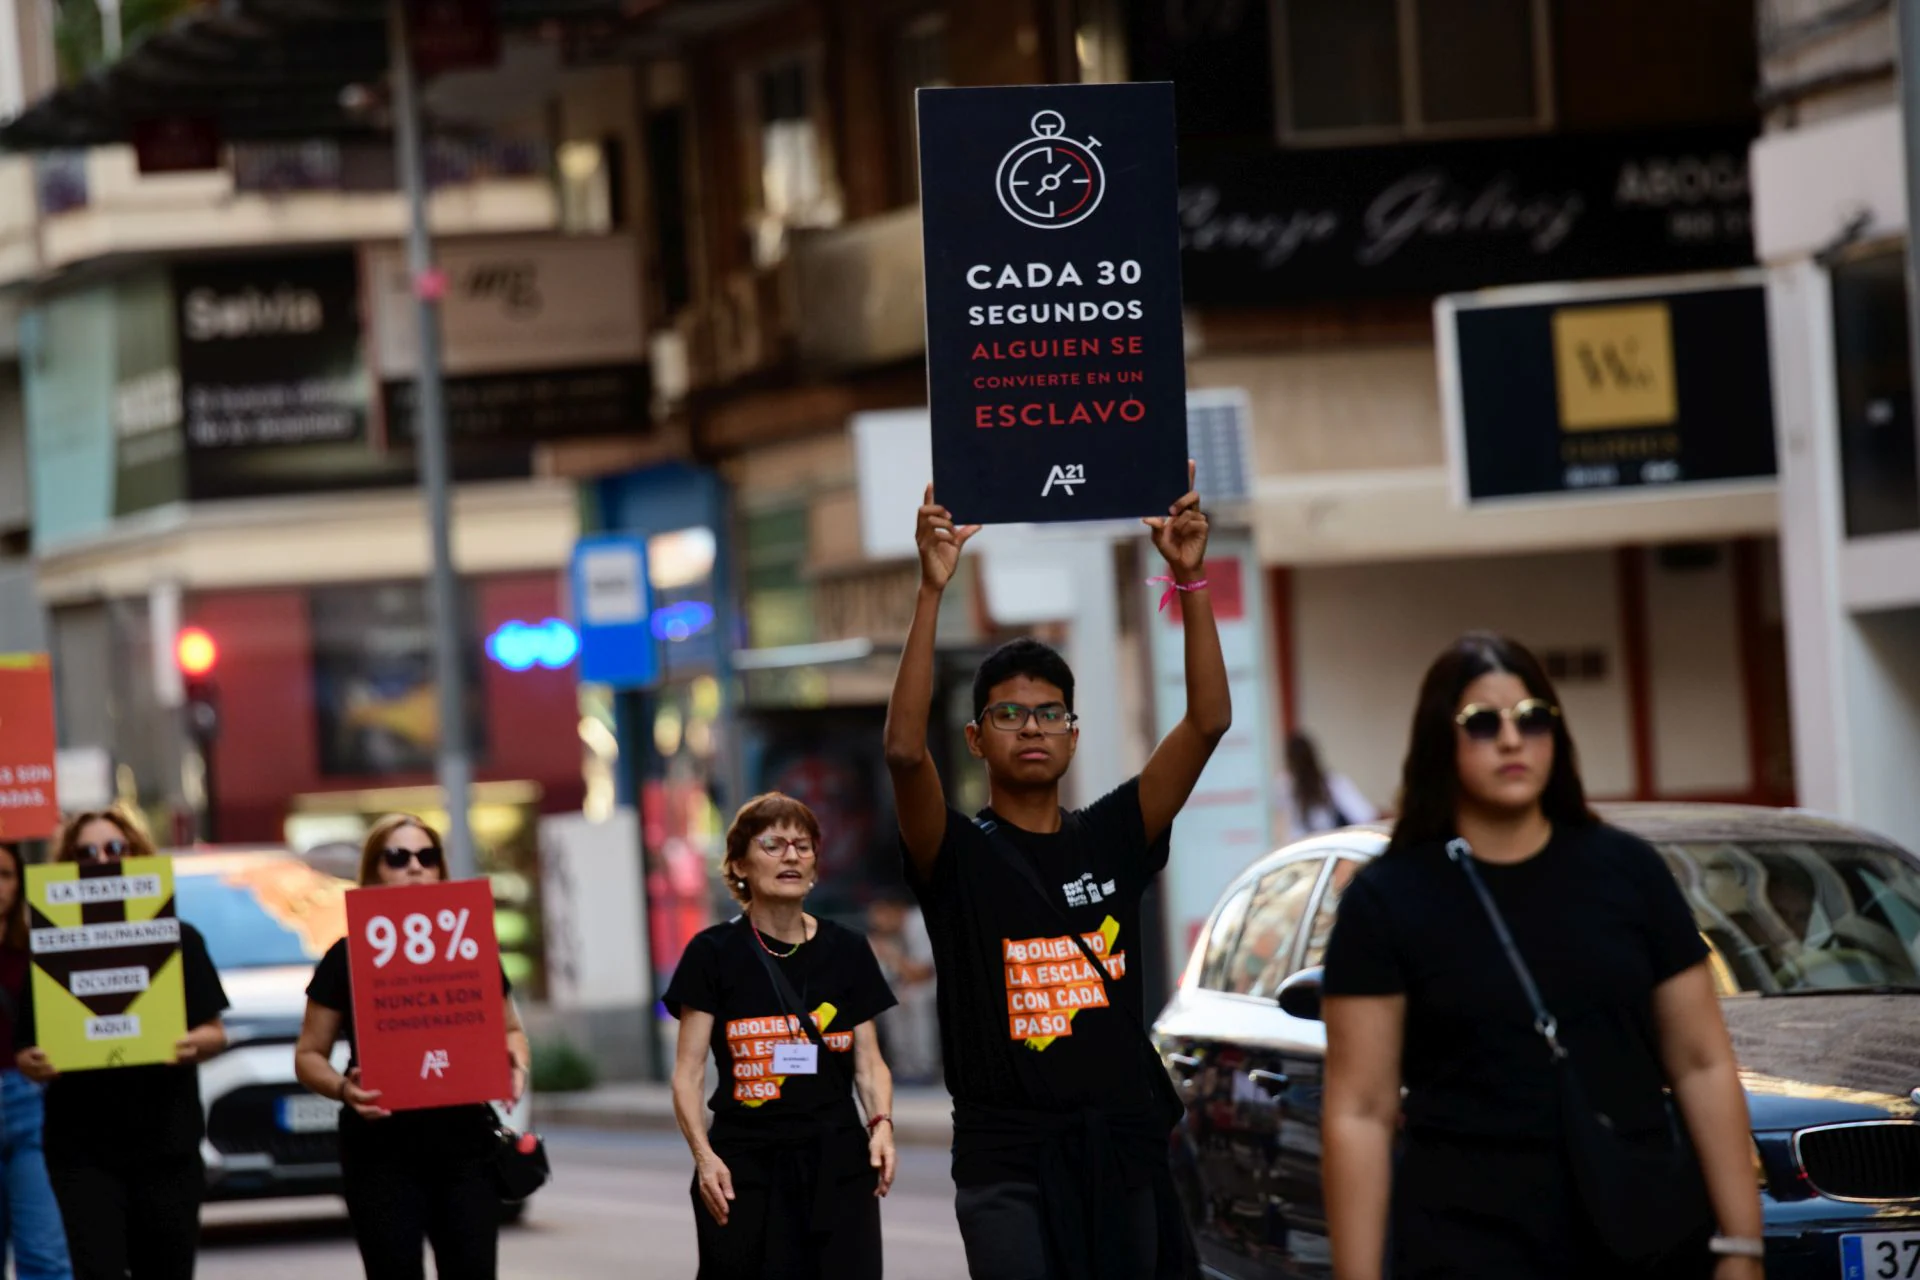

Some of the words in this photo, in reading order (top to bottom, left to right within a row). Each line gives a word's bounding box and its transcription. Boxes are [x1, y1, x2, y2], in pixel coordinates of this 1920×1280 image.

[966, 261, 1083, 290] CADA
[1097, 260, 1142, 285] 30
[968, 300, 1143, 326] SEGUNDOS
[971, 338, 1100, 360] ALGUIEN
[1111, 336, 1143, 355] SE
[973, 373, 1081, 389] CONVIERTE
[1087, 371, 1111, 385] EN
[1117, 370, 1143, 383] UN
[975, 399, 1145, 428] ESCLAVO
[1041, 463, 1086, 497] A21
[52, 886, 73, 899] LA
[79, 881, 131, 896] TRATA
[135, 880, 153, 892] DE
[38, 932, 88, 945] SERES
[95, 924, 179, 941] HUMANOS
[365, 908, 479, 969] 98%
[78, 974, 140, 988] OCURRE
[1009, 967, 1032, 985] LA
[374, 991, 440, 1009] NUNCA
[445, 987, 483, 1005] SON
[1012, 991, 1050, 1010] CON
[1056, 986, 1104, 1006] CADA
[376, 1009, 486, 1032] CONDENADOS
[1015, 1015, 1066, 1036] PASO
[731, 1044, 750, 1057] LA
[735, 1062, 764, 1077] CON
[736, 1082, 777, 1098] PASO
[1876, 1240, 1920, 1280] 37
